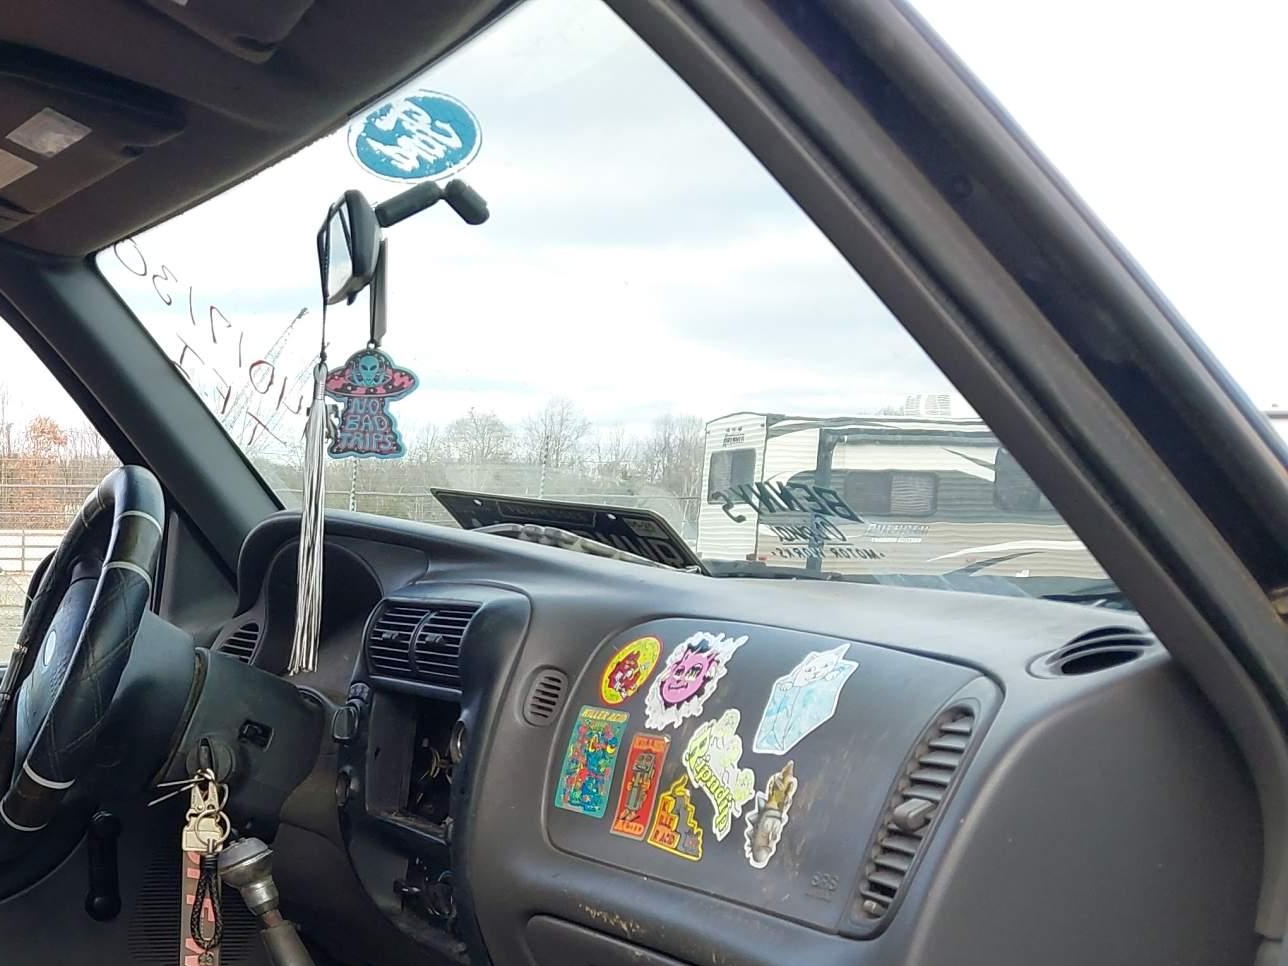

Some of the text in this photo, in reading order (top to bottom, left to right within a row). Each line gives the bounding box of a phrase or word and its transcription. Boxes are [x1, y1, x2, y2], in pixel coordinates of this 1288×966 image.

[350, 398, 380, 415] NO
[344, 414, 388, 432] BAD
[338, 431, 394, 450] TRIPS
